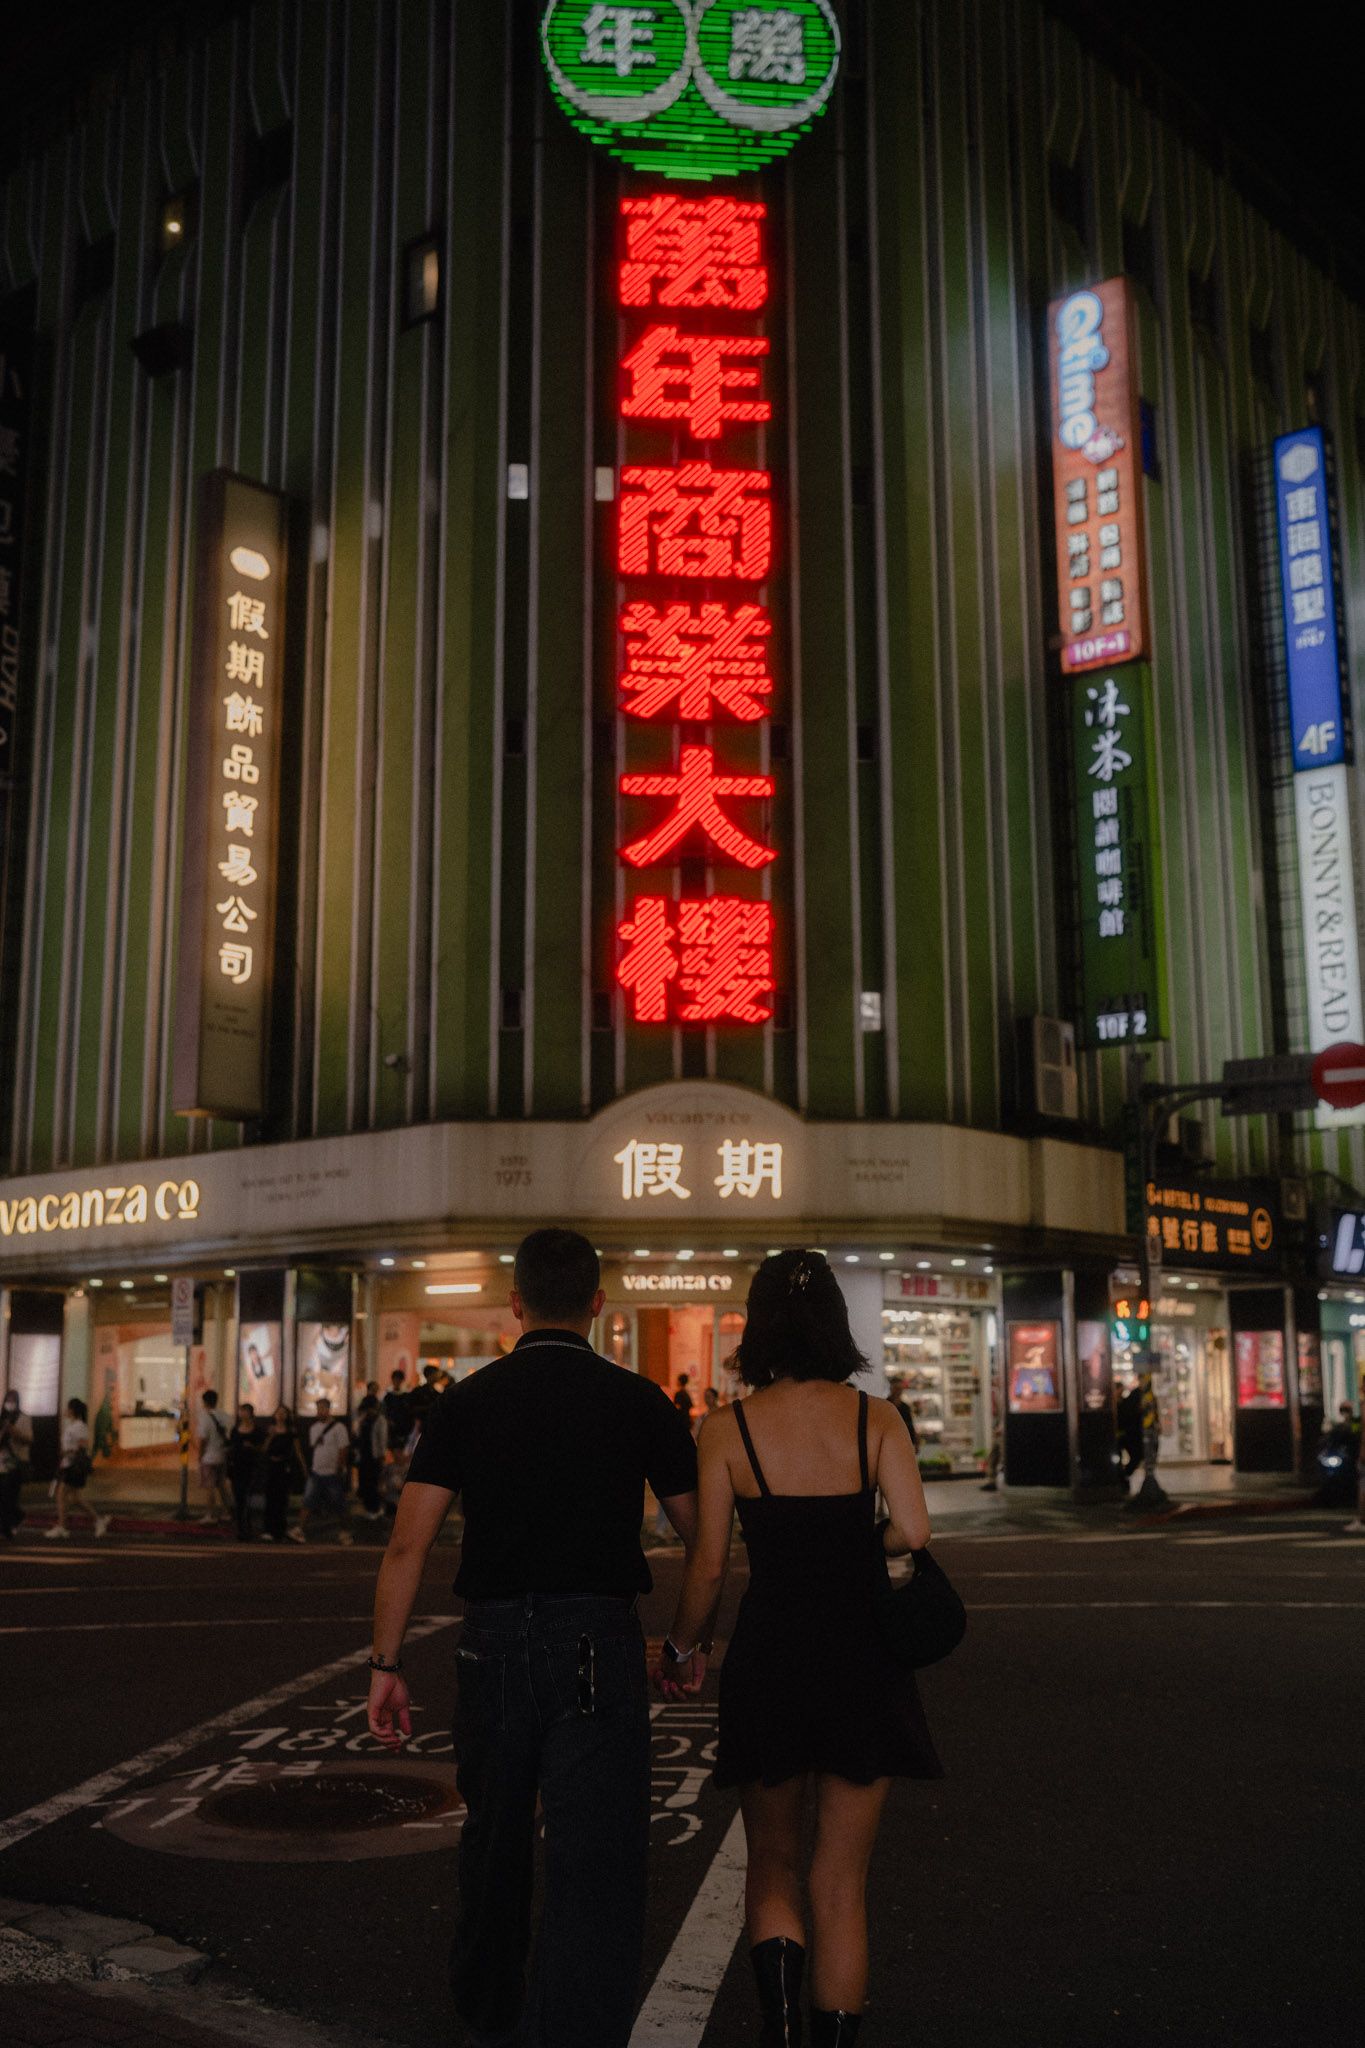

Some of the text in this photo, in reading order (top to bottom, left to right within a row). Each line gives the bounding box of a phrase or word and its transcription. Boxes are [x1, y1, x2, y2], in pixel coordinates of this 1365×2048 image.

[617, 194, 778, 1024] 萬年商業大樓
[1298, 720, 1336, 756] 4F
[216, 590, 270, 985] 假期飾品貿易公司
[1308, 782, 1351, 1034] BONNY & READ
[613, 1138, 784, 1201] 假期
[0, 1183, 147, 1236] vacanza
[622, 1275, 706, 1290] vacanza
